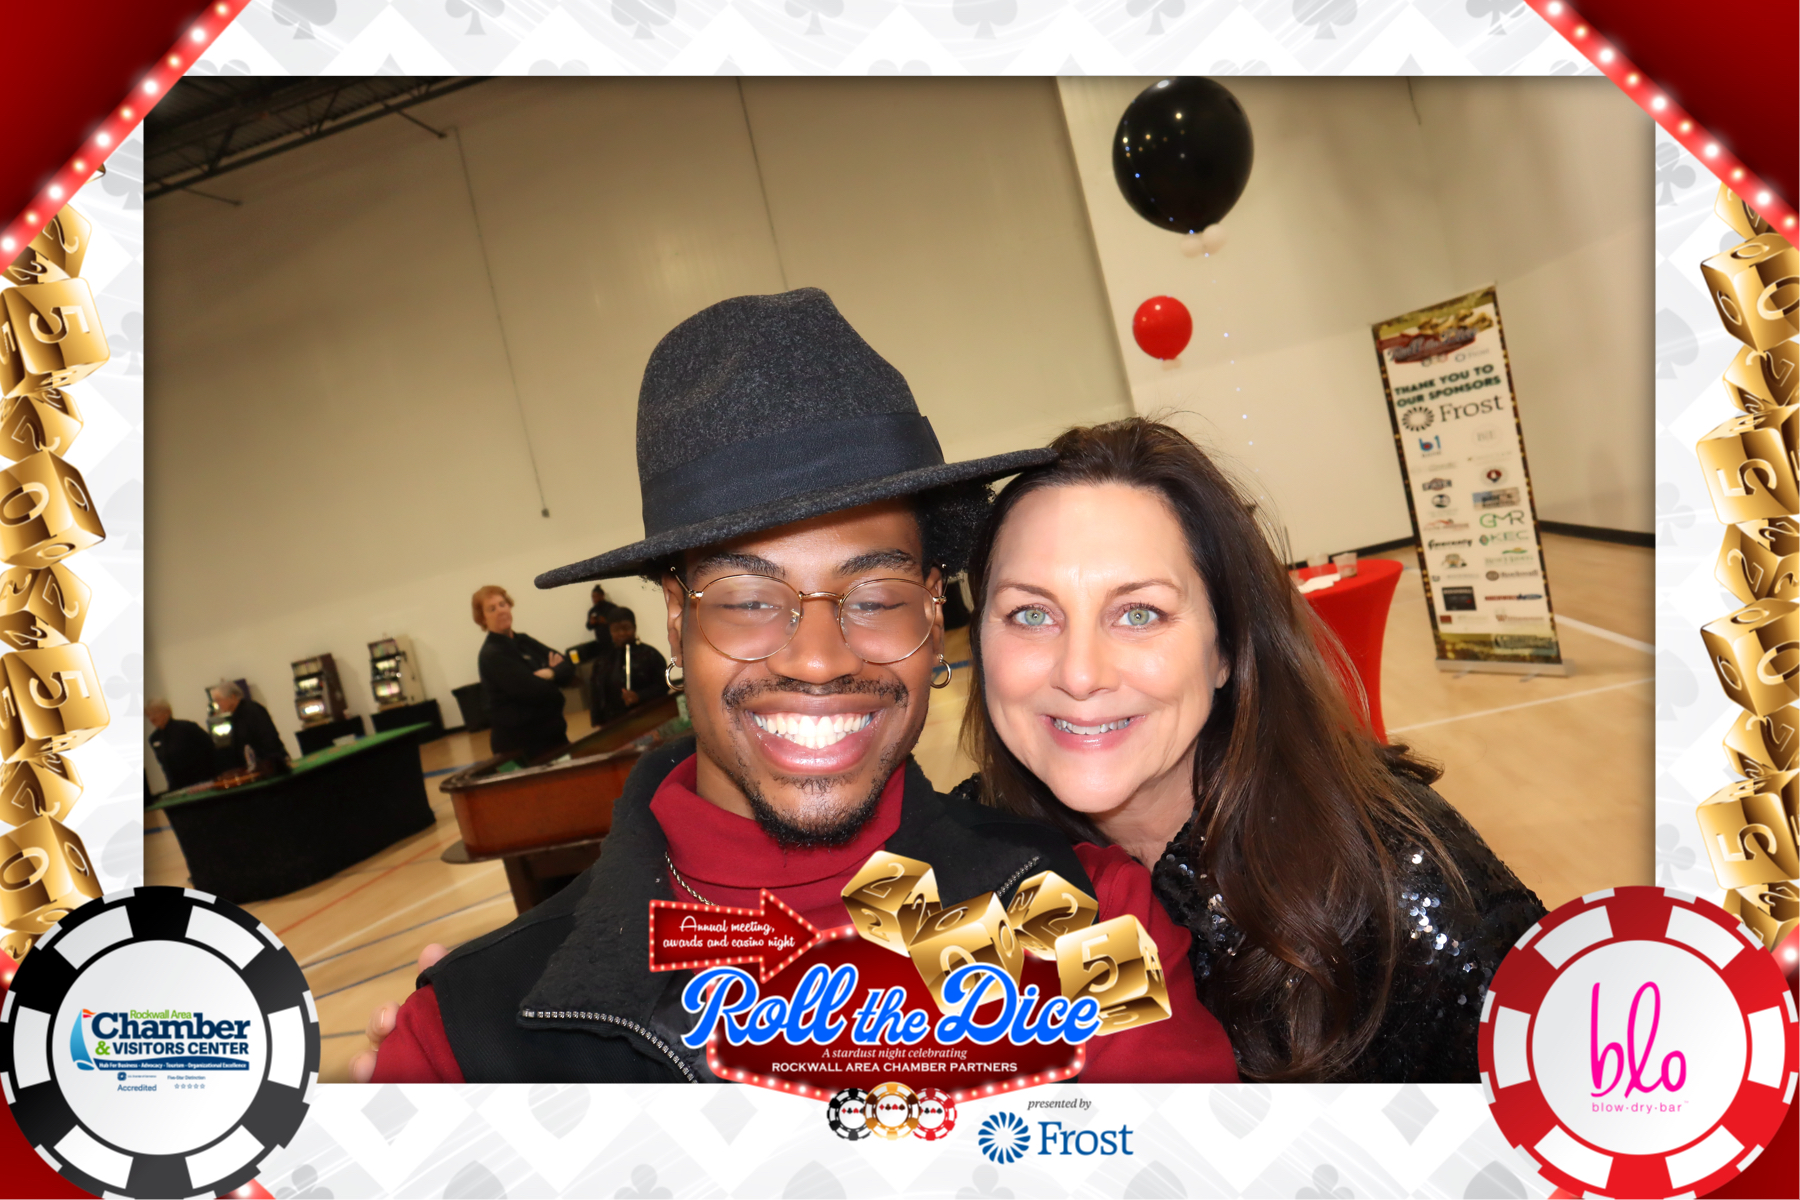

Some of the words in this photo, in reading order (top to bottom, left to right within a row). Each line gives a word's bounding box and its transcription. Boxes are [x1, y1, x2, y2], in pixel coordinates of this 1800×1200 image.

[1394, 379, 1436, 396] THANK
[1439, 370, 1470, 385] YOU
[1473, 364, 1494, 377] TO
[1396, 394, 1425, 408] OUR
[1429, 375, 1502, 401] SPONSORS
[1438, 394, 1504, 423] Frost
